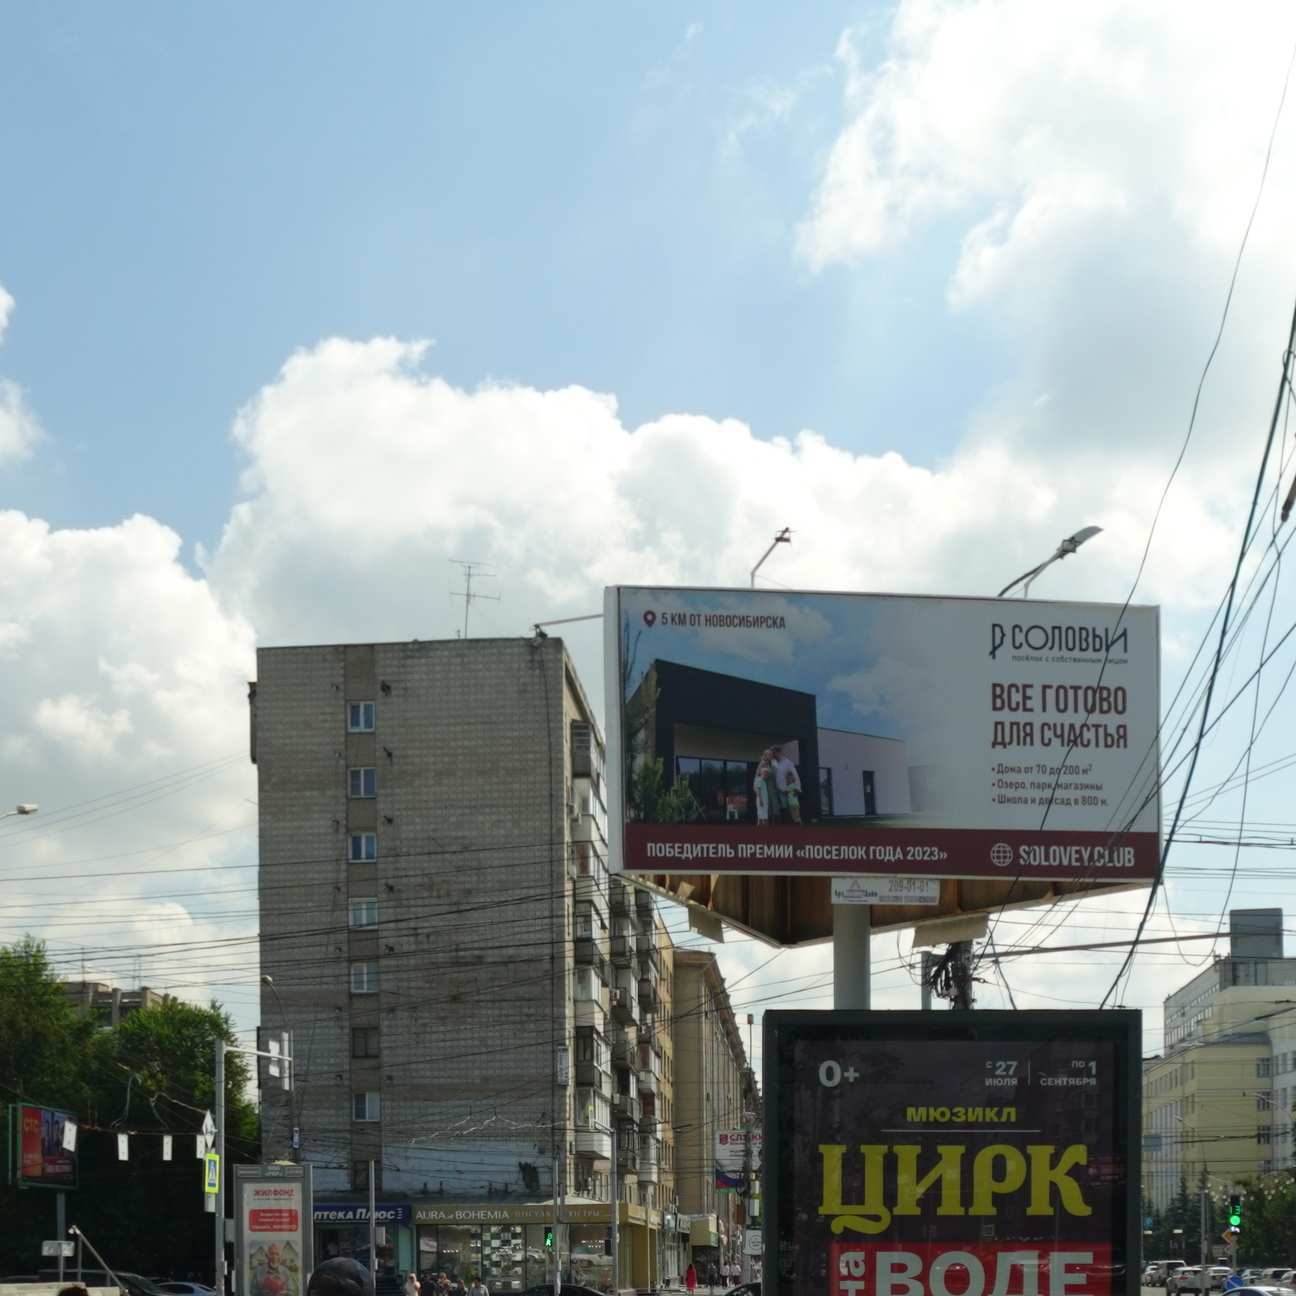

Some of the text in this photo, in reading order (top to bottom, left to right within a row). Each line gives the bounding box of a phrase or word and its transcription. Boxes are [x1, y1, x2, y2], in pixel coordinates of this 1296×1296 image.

[661, 612, 786, 629] 5 КМ ОТ НОВОСИБИРСКА
[1011, 624, 1128, 653] СОЛОВЬИ
[991, 682, 1127, 715] ВСЕ ГОТОВО
[991, 721, 1128, 749] ДЛЯ СЧАСТЬЯ
[996, 763, 1022, 775] Дома
[1024, 766, 1034, 774] от
[1035, 764, 1047, 775] 70
[1063, 765, 1080, 776] 200
[997, 795, 1029, 805] Школа
[1081, 796, 1099, 806] 800
[647, 843, 948, 862] ПОБЕДИТЕЛЬ ПРЕМИИ «ПОСЕЛОК ГОДА 2023»
[1019, 845, 1135, 867] SOLOVEY.CLUB
[818, 1060, 860, 1088] 0+
[995, 1060, 1018, 1076] 27
[1088, 1061, 1097, 1076] 1
[985, 1077, 1018, 1087] ИЮЛЯ
[1040, 1077, 1097, 1087] СЕНТЯБРЯ
[906, 1106, 1017, 1123] МЮЗИКЛ
[818, 1144, 1092, 1234] ЦИРК
[456, 1209, 510, 1220] BOHEMIA
